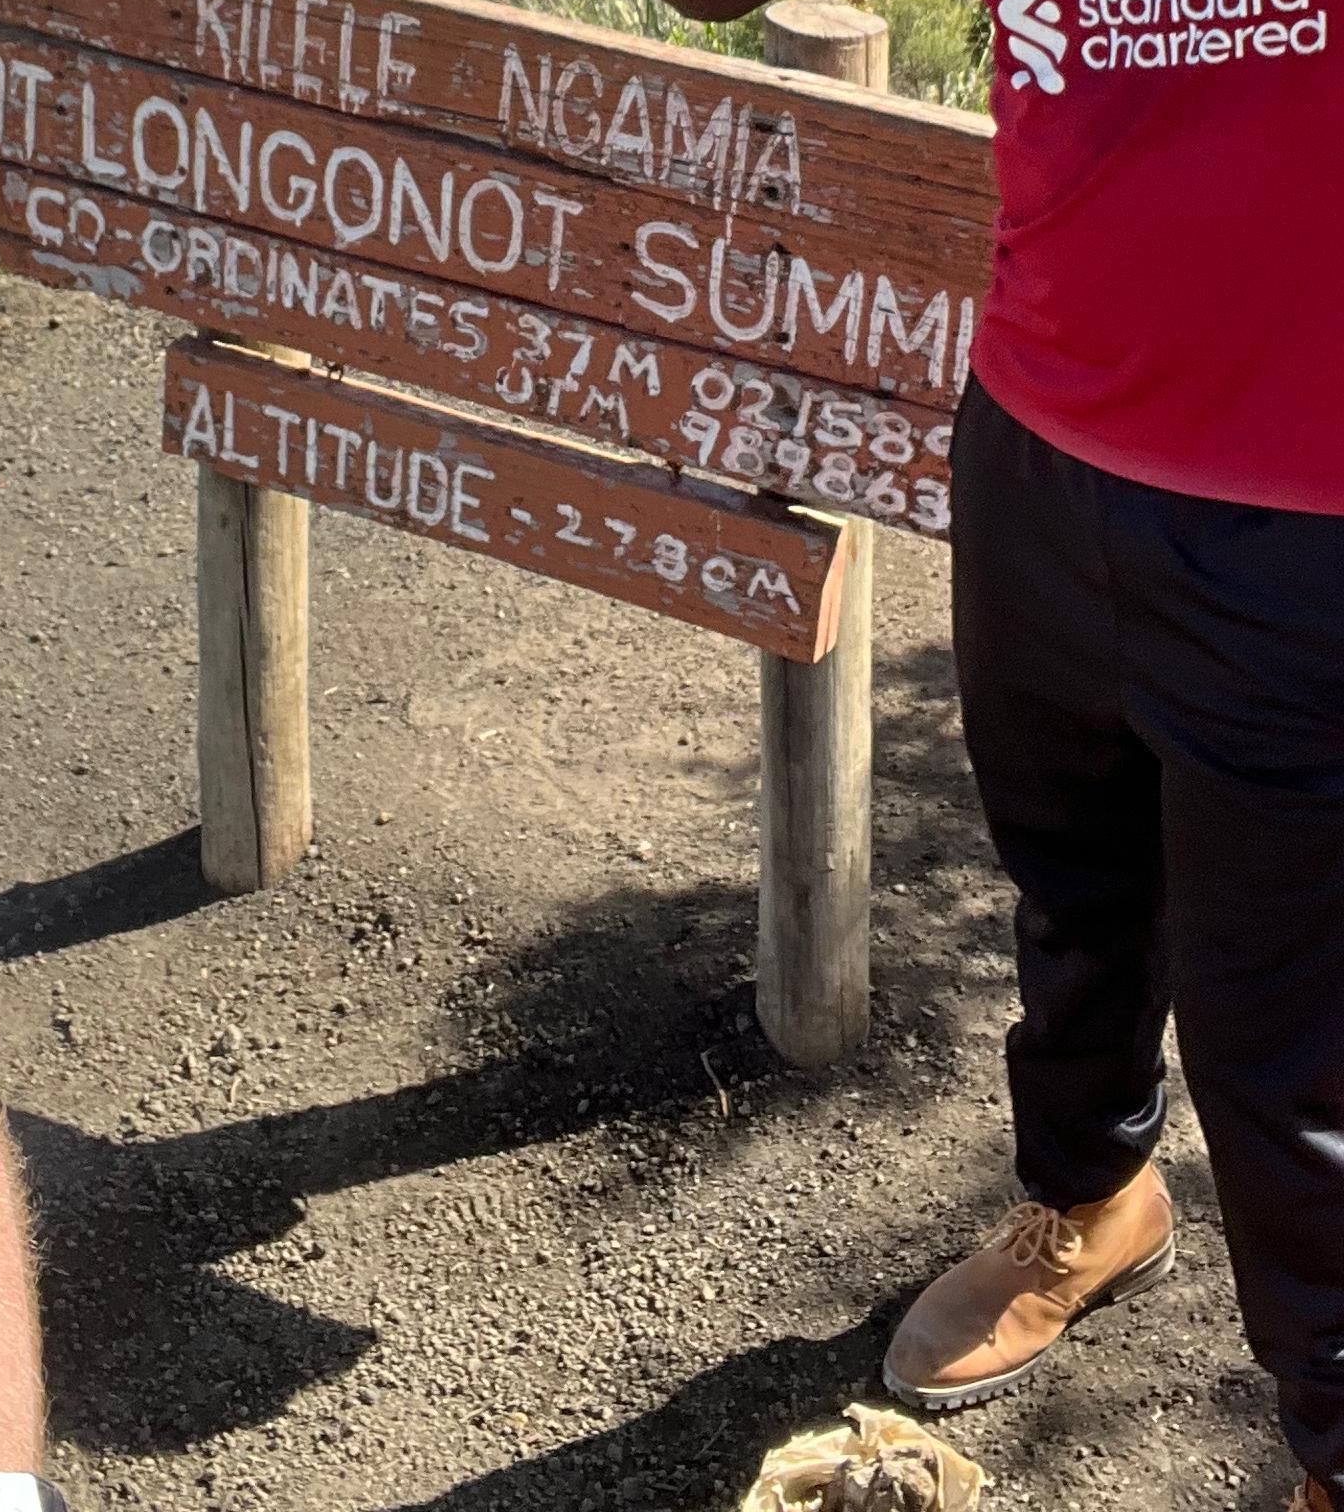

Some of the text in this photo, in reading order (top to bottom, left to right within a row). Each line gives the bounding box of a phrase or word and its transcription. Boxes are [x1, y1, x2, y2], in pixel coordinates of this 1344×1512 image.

[1081, 9, 1327, 70] chartered
[81, 81, 584, 292] LONGONOT
[499, 43, 802, 216] NGAMIA
[25, 186, 490, 362] CO-ORDINATES
[183, 384, 495, 543] ALTITUDE
[495, 365, 630, 439] UTM
